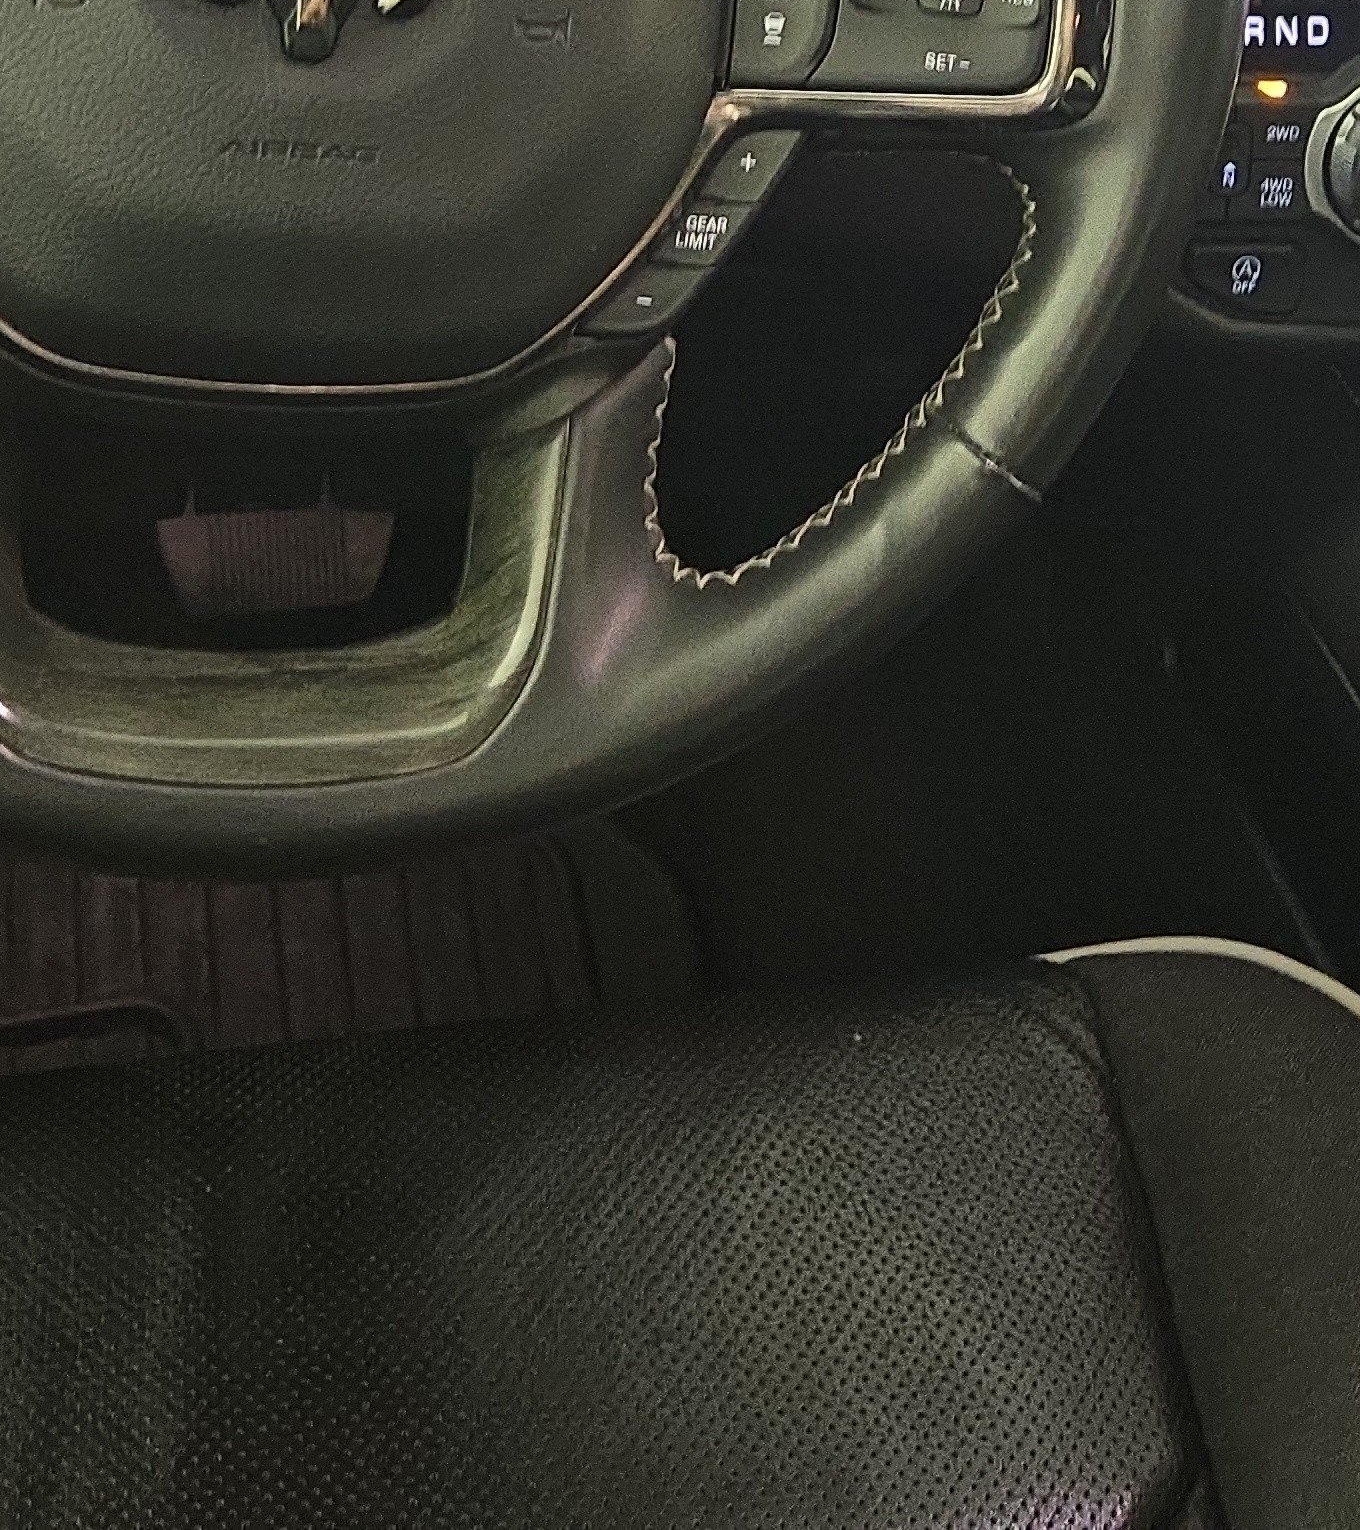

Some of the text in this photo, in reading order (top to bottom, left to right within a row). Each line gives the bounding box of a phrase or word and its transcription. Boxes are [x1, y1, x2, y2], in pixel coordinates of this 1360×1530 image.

[1244, 15, 1330, 47] R N D
[1259, 190, 1293, 209] LOW
[686, 214, 728, 234] GEAR
[675, 231, 719, 251] LIMIT
[1232, 279, 1257, 295] OFF
